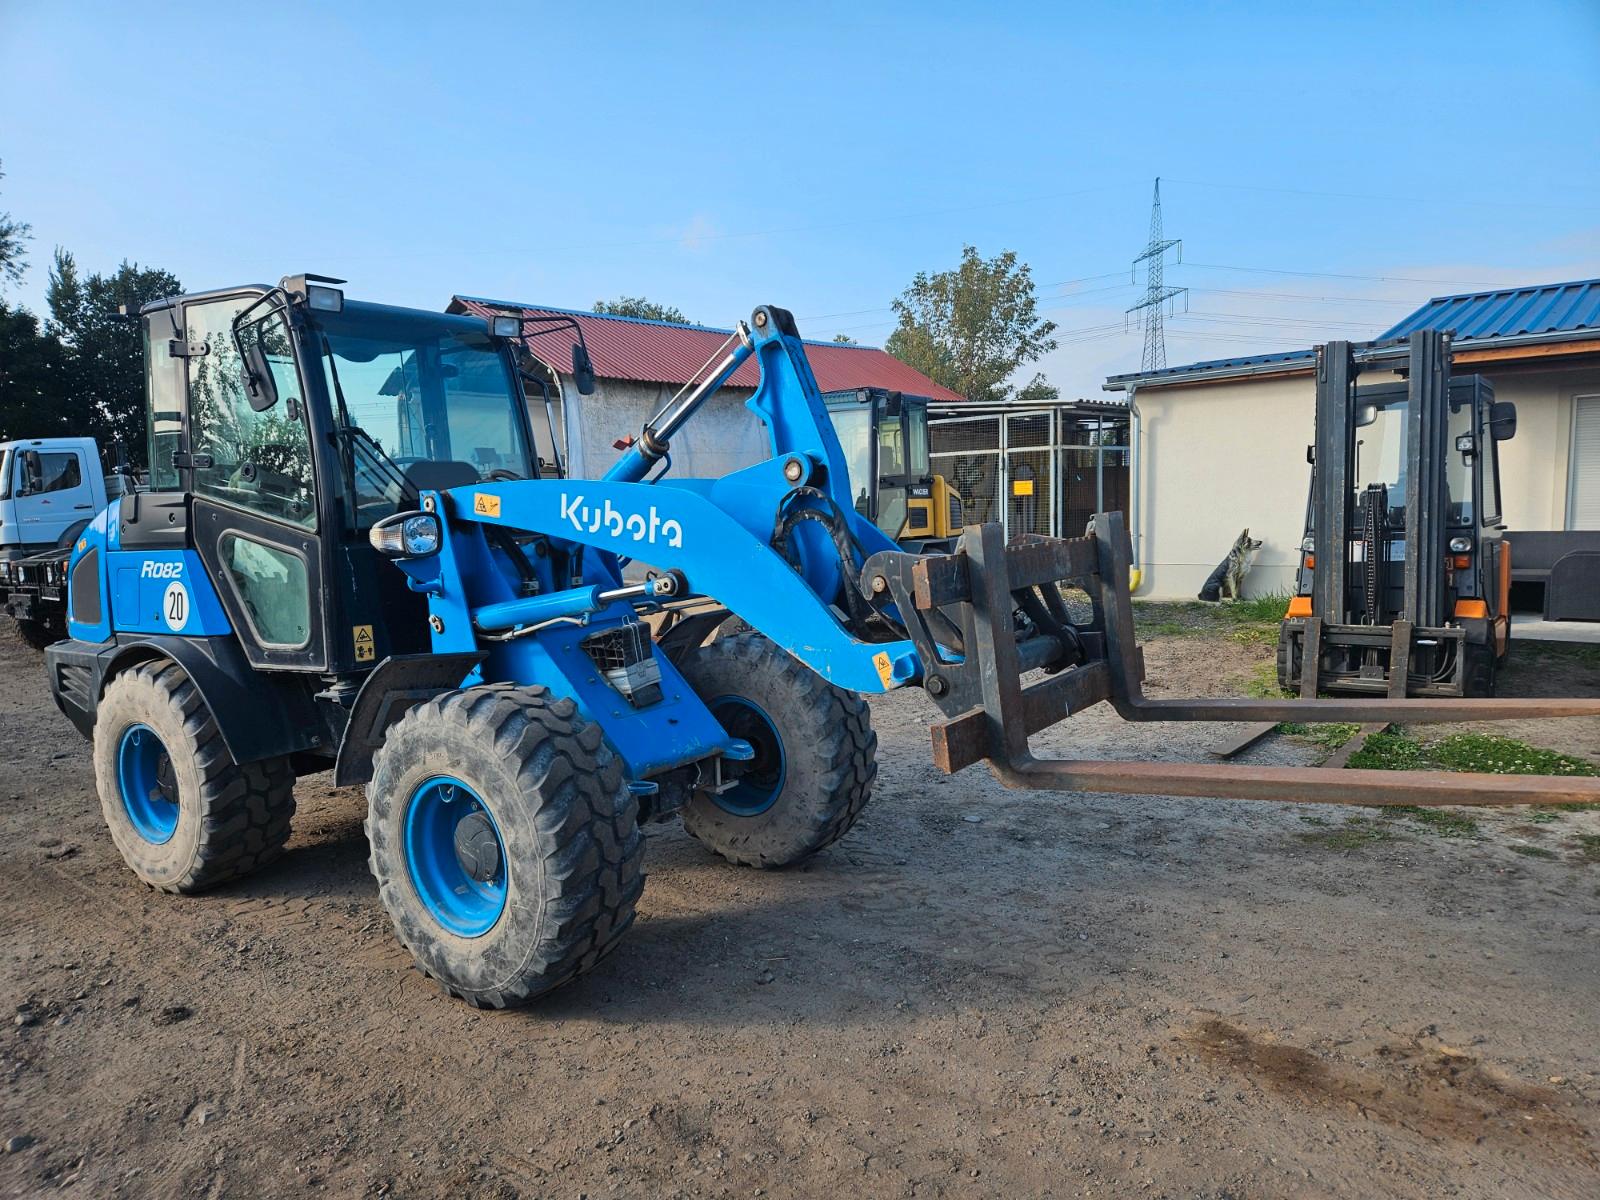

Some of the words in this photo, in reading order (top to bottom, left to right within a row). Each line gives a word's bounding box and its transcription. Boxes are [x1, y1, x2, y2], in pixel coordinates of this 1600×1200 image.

[560, 493, 682, 548] Kubota
[141, 560, 184, 579] R082
[169, 591, 184, 621] 20
